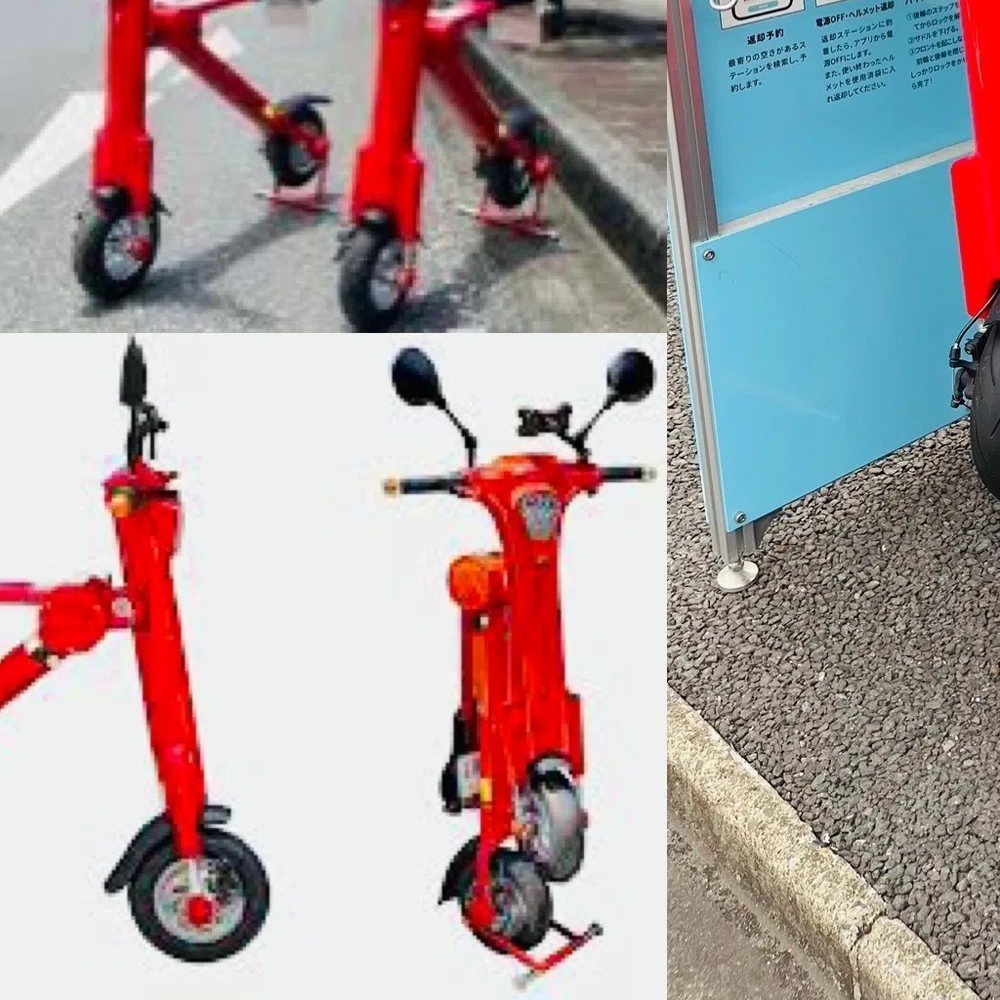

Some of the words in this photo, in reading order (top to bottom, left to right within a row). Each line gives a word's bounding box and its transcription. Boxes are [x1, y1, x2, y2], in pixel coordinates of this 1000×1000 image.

[746, 28, 784, 46] 返却予約
[728, 41, 807, 68] 最寄りの空きがあるス
